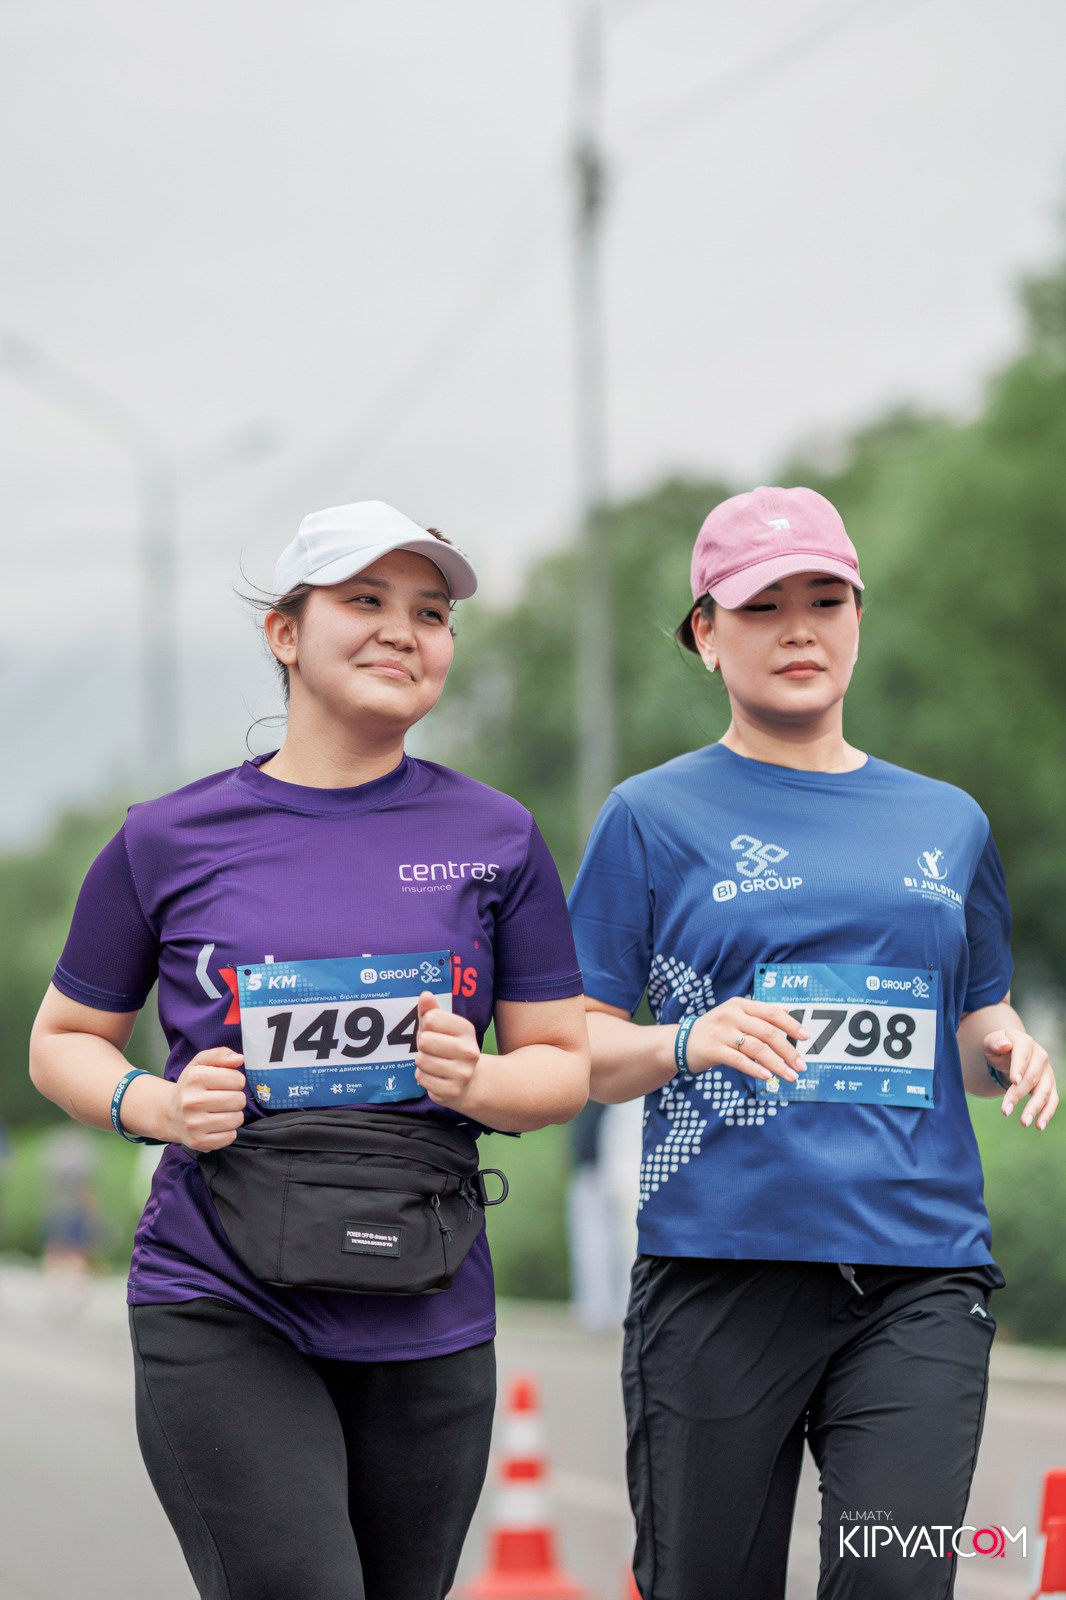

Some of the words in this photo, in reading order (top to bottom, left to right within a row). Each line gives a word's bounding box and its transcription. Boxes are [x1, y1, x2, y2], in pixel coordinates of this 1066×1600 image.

[399, 861, 499, 882] centras
[402, 884, 452, 893] insurance
[740, 877, 802, 892] GROUP
[904, 877, 918, 887] BI
[247, 973, 262, 991] 5
[268, 975, 297, 989] KM
[379, 968, 419, 980] GROUP
[450, 955, 478, 998] is
[762, 971, 777, 988] 5
[781, 975, 809, 988] KM
[881, 979, 912, 990] GROUP
[267, 1005, 419, 1063] 1494
